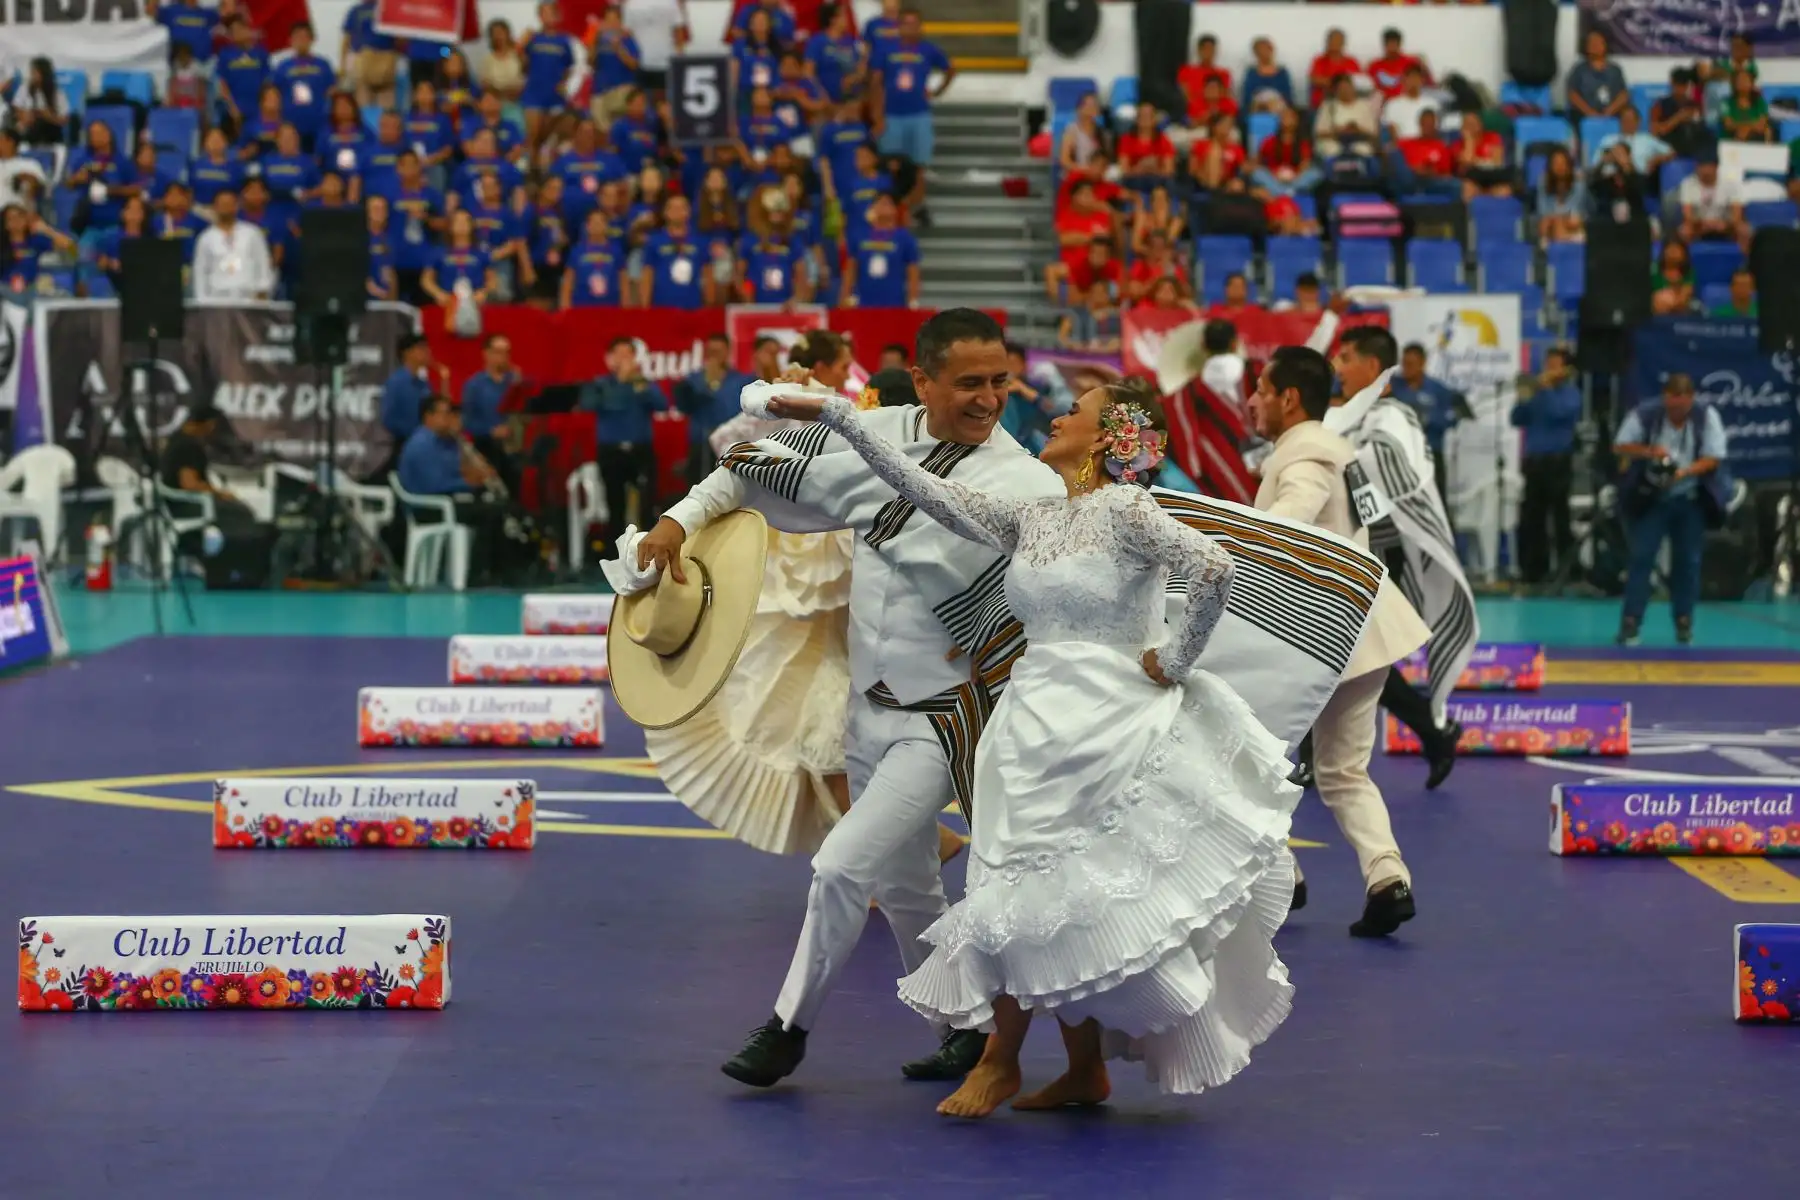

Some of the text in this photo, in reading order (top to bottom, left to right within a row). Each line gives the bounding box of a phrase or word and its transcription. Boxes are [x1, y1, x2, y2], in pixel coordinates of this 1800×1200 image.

[682, 66, 720, 118] 5
[415, 696, 553, 714] Club Libertad
[1492, 703, 1578, 723] Libertad
[283, 785, 459, 808] Club Libertad
[1624, 793, 1793, 816] Club Libertad
[113, 926, 347, 957] Club Libertad
[195, 961, 265, 975] TRUJILLO
